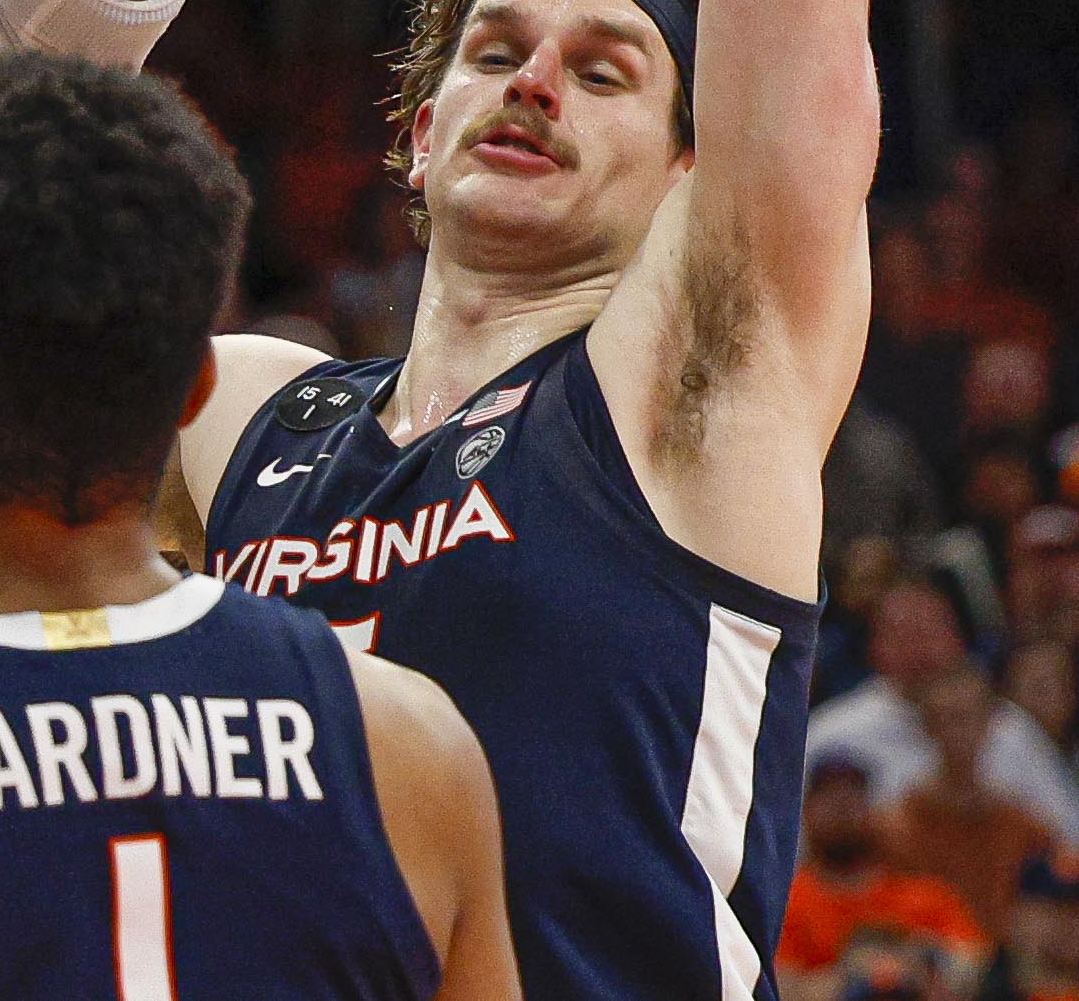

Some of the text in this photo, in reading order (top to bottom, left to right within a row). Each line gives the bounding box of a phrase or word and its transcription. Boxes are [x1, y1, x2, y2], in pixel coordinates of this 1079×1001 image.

[296, 385, 352, 407] 15 41
[215, 479, 516, 598] VIRGINIA
[108, 833, 178, 1001] 1
